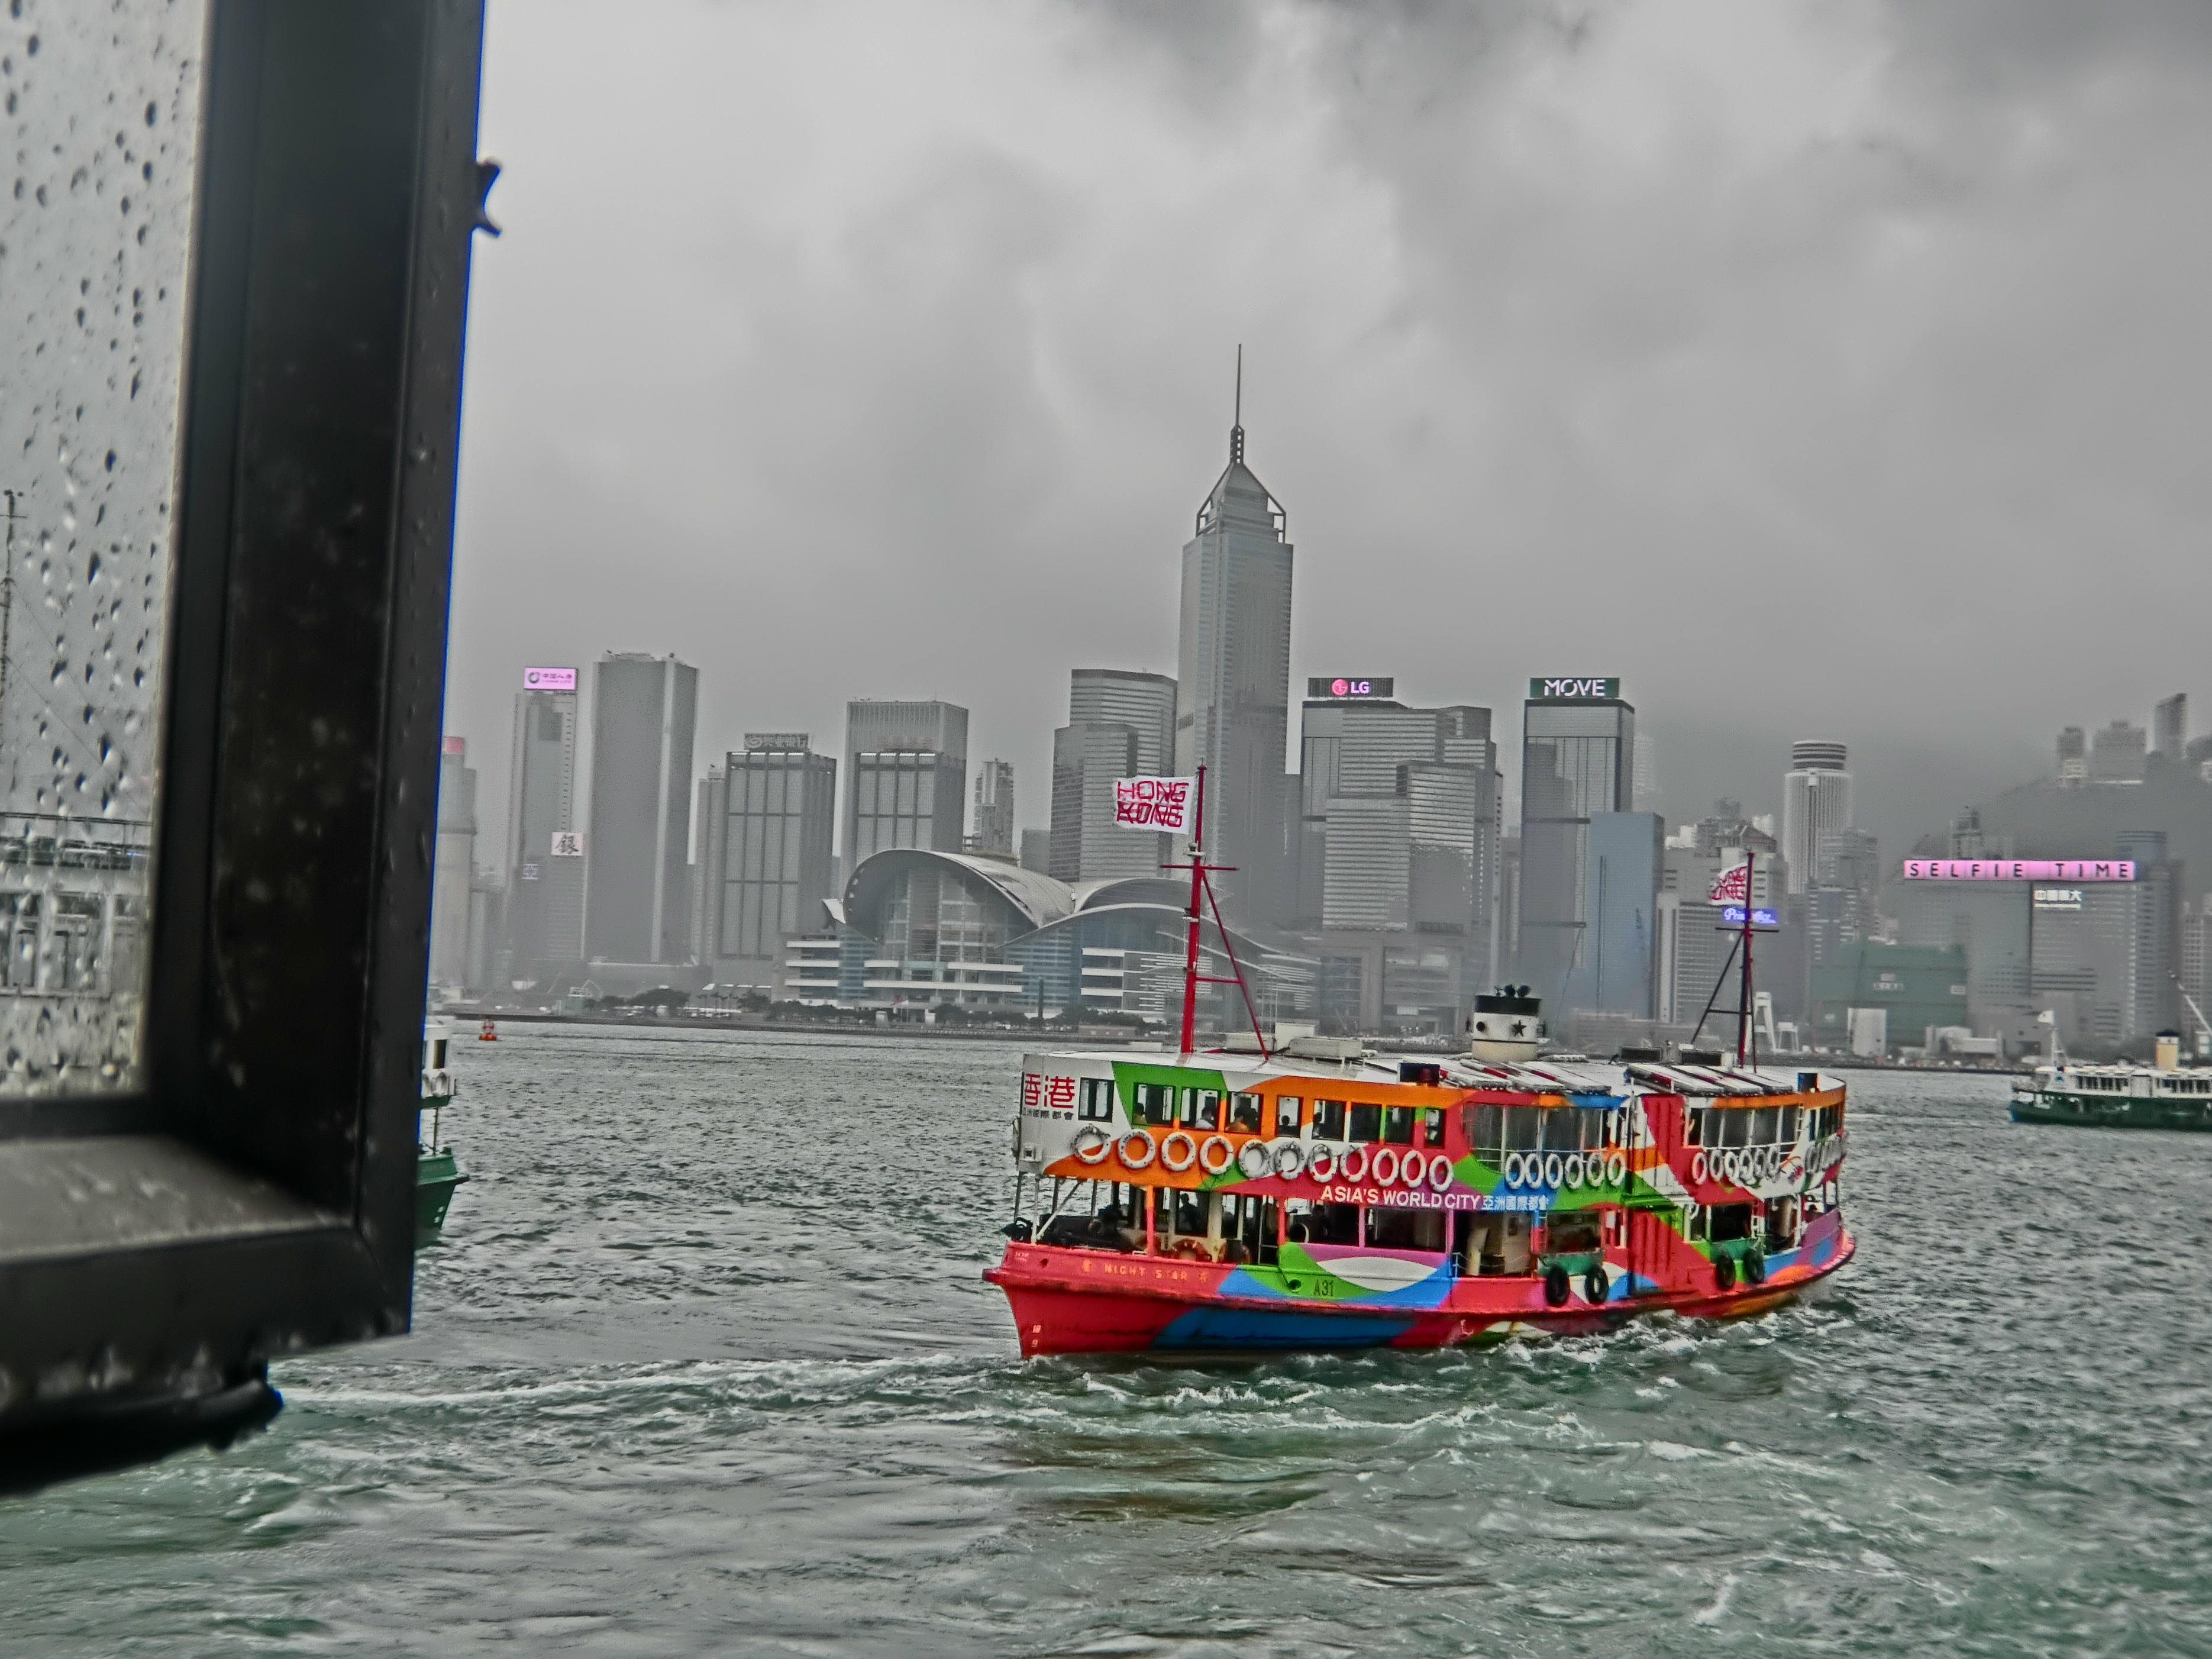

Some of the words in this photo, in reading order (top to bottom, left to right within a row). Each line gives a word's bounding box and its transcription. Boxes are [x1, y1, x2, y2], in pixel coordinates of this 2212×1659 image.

[1351, 681, 1370, 694] LG
[1544, 679, 1606, 696] MOVE
[1117, 780, 1189, 803] HONG
[1116, 801, 1184, 828] KONG
[1909, 863, 2023, 878] SELFIE
[2055, 863, 2128, 878] TIME
[1025, 1073, 1076, 1109] 香港
[1320, 1185, 1379, 1205] ASIA'S
[1383, 1189, 1442, 1208] WORLD
[1444, 1193, 1481, 1210] CITY
[1104, 1263, 1146, 1277] NIGHT
[1314, 1279, 1334, 1297] A31
